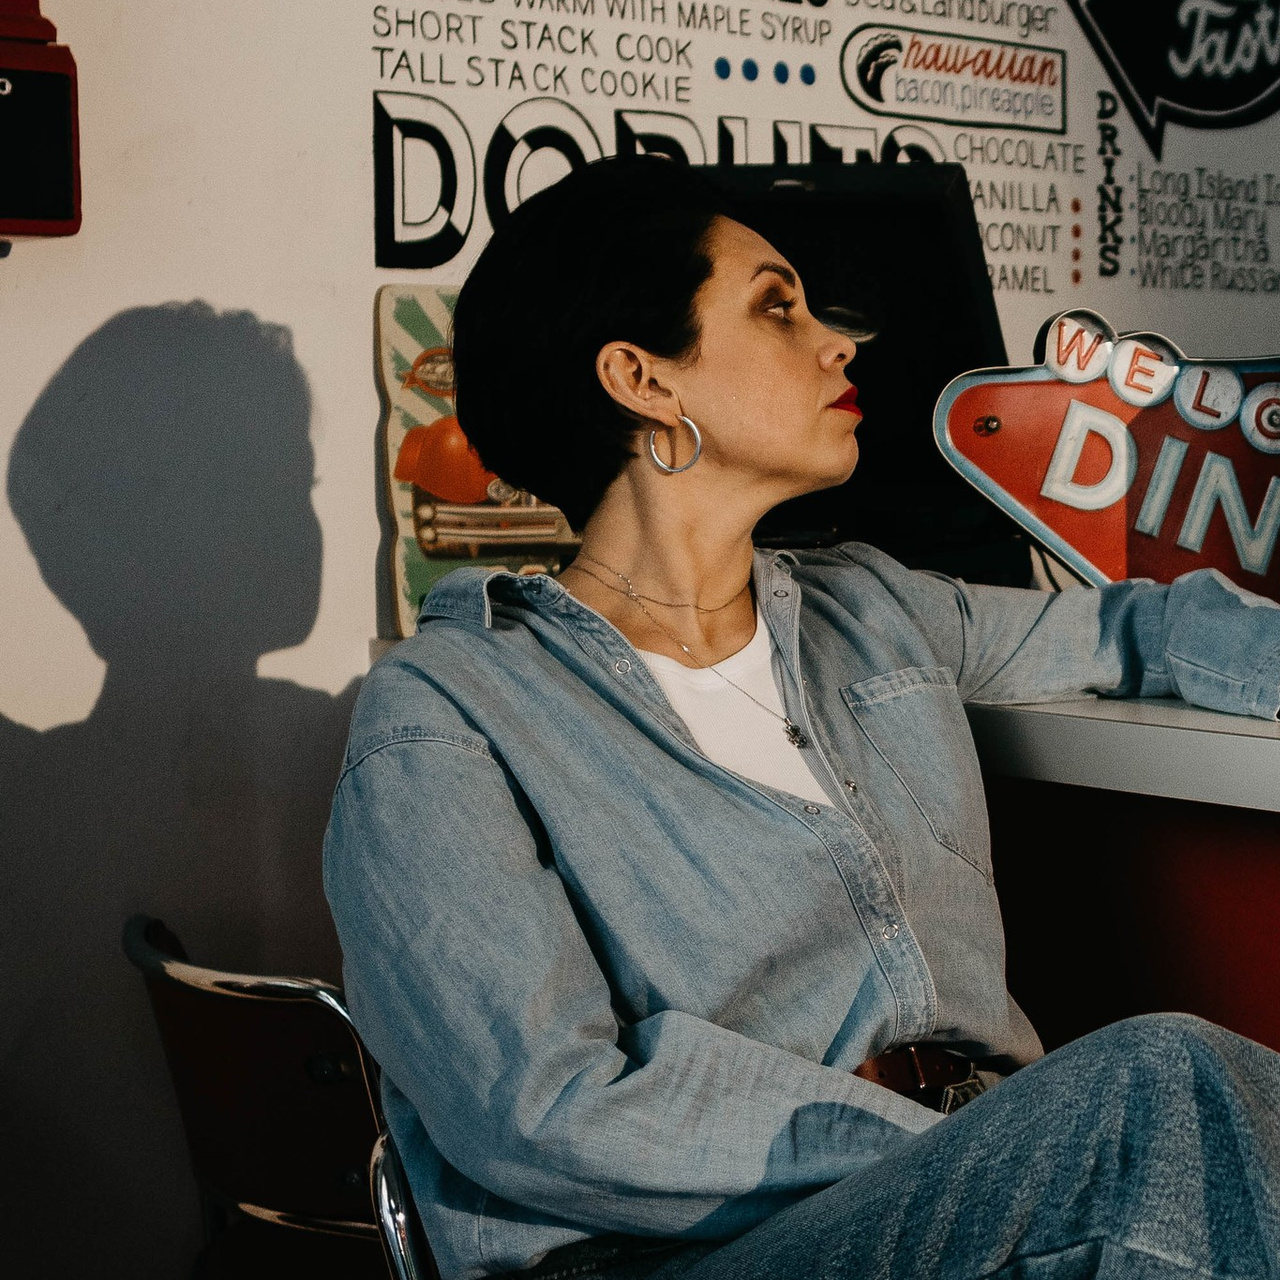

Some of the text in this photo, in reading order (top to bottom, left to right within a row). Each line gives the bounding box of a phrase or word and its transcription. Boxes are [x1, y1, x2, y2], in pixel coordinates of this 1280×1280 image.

[372, 5, 694, 69] SHORT STACK COOK
[676, 0, 751, 38] MAPLE
[759, 11, 832, 48] SYRUP
[372, 46, 693, 105] TALL STACK COOKIE
[903, 33, 1059, 87] hawaiian
[953, 132, 1086, 172] CHOCOLATE
[1097, 90, 1124, 277] DRINKS
[1138, 160, 1190, 201] Long
[979, 222, 1062, 254] CONUT
